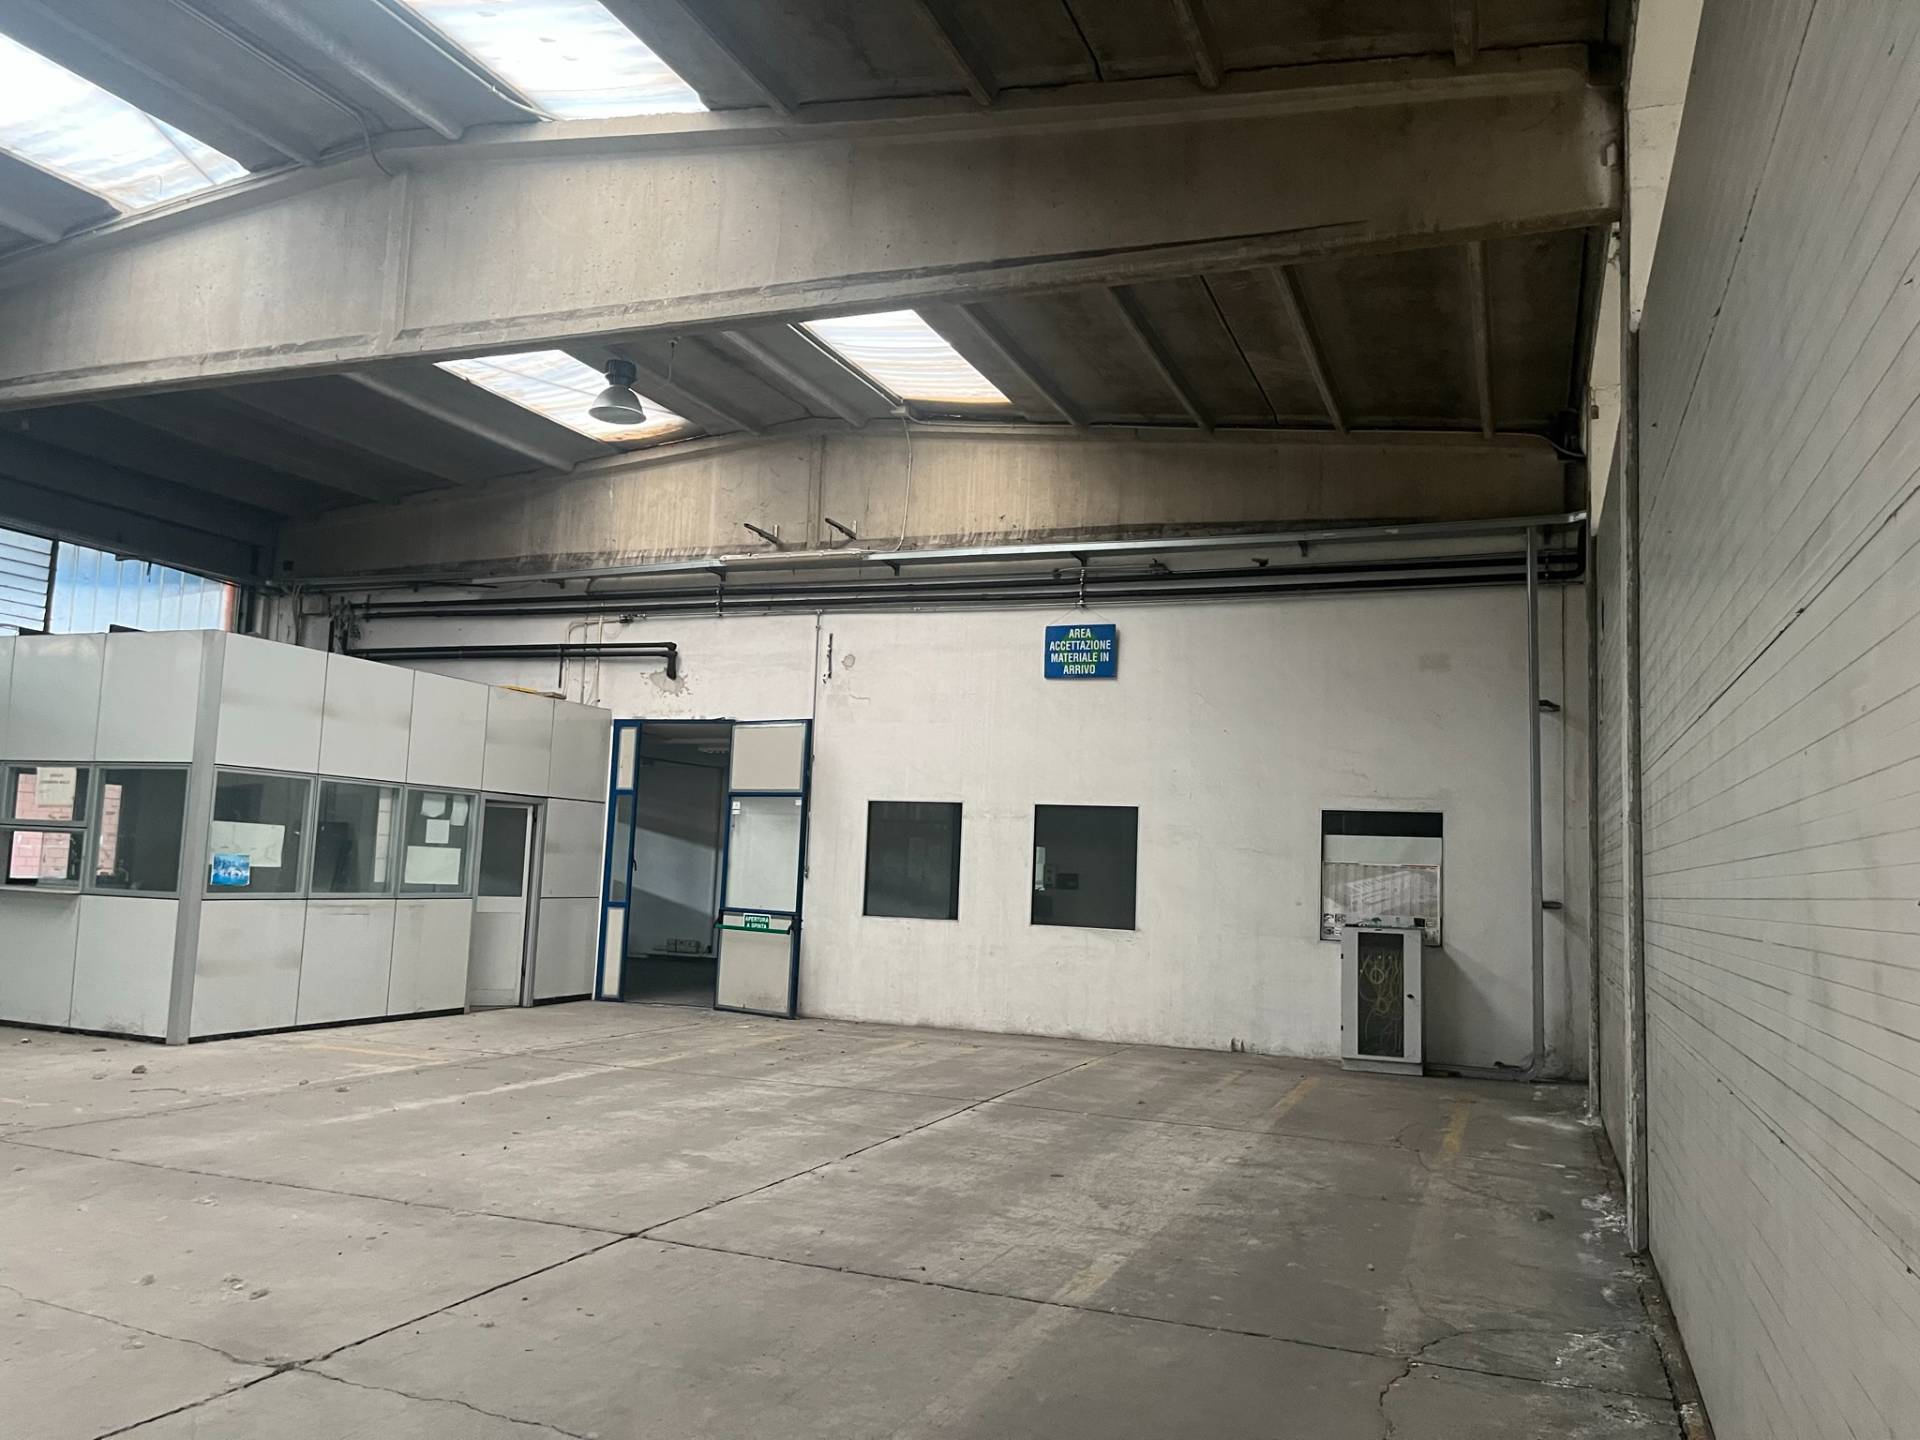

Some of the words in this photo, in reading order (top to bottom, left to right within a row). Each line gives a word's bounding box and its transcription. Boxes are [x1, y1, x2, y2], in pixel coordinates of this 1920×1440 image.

[1068, 628, 1092, 638] AREA
[1049, 639, 1111, 651] ACCETTAZIONE
[1050, 652, 1098, 663] MATERIALE
[1100, 652, 1109, 662] IN
[1063, 664, 1096, 674] ARRIVO
